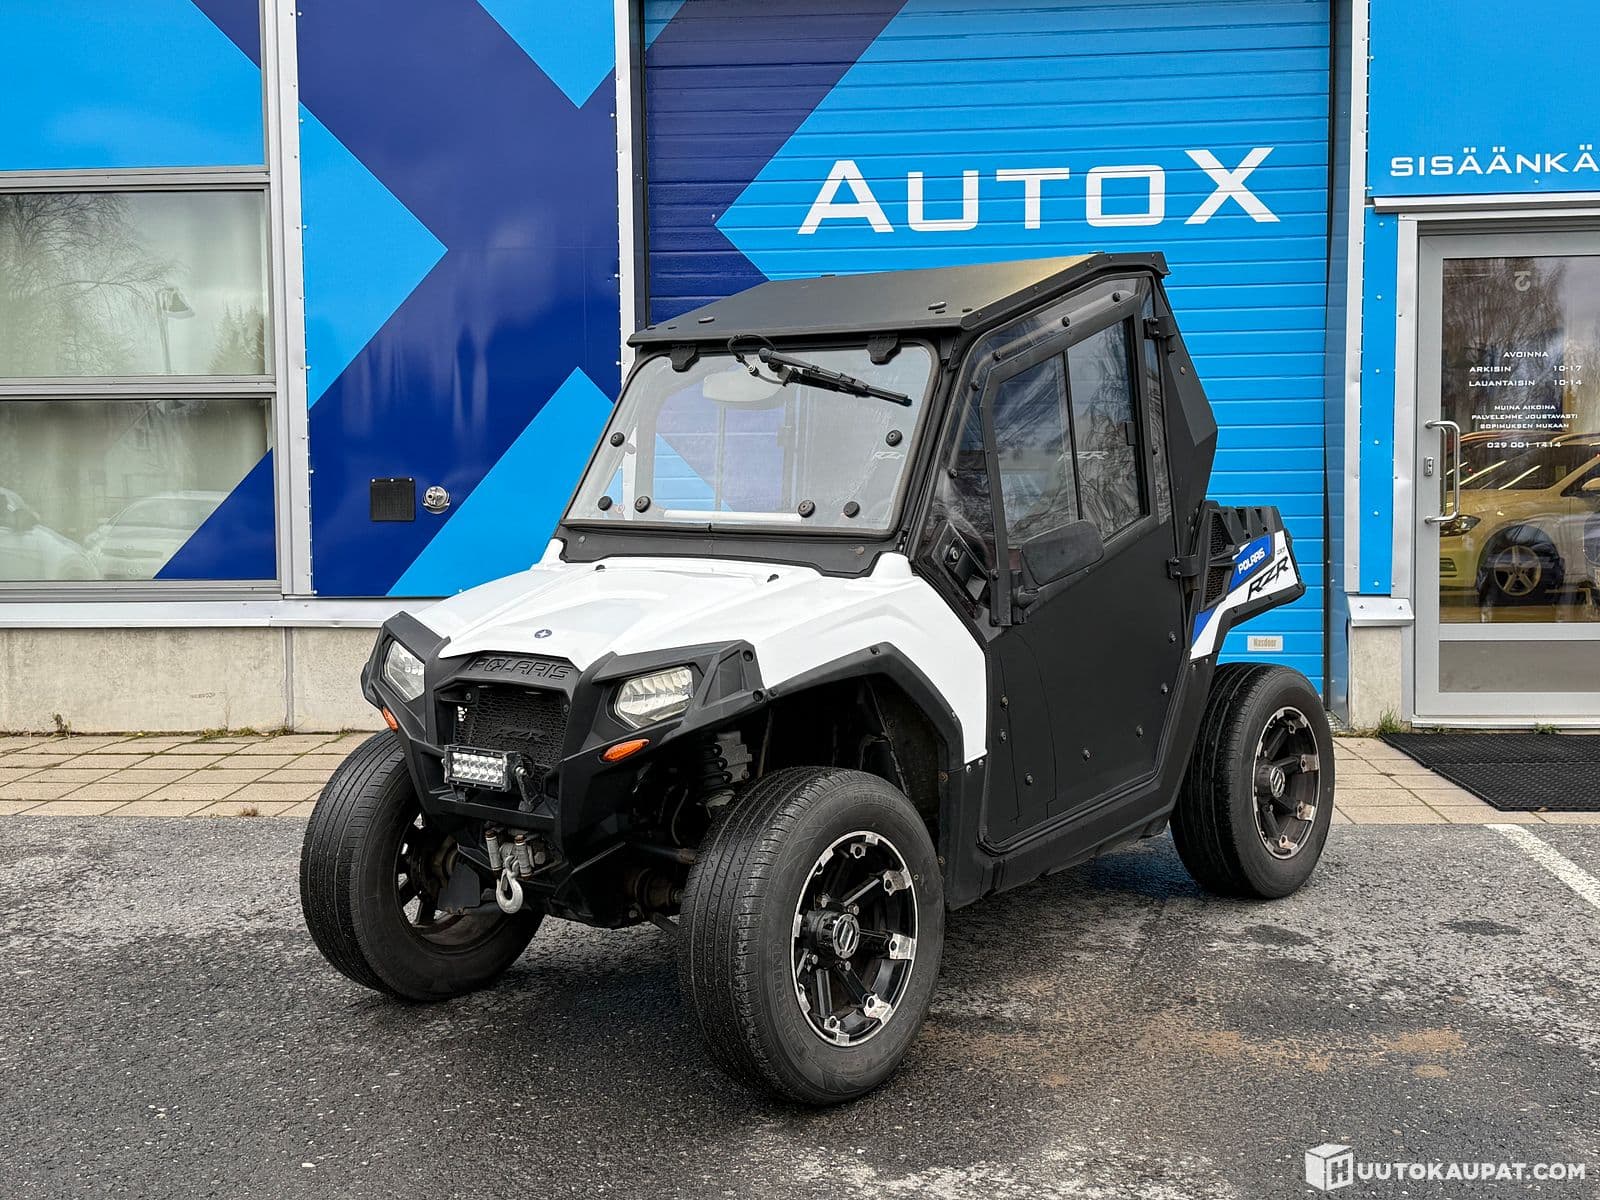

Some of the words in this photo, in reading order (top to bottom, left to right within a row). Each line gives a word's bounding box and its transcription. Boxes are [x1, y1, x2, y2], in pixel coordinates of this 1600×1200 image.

[1390, 144, 1600, 177] SISÄÄNKÄ
[797, 147, 1280, 235] AUTOX
[1469, 365, 1512, 373] ARKISIN
[1237, 547, 1266, 575] POLARIS
[1247, 556, 1289, 601] RZR
[467, 655, 574, 680] POLARIS
